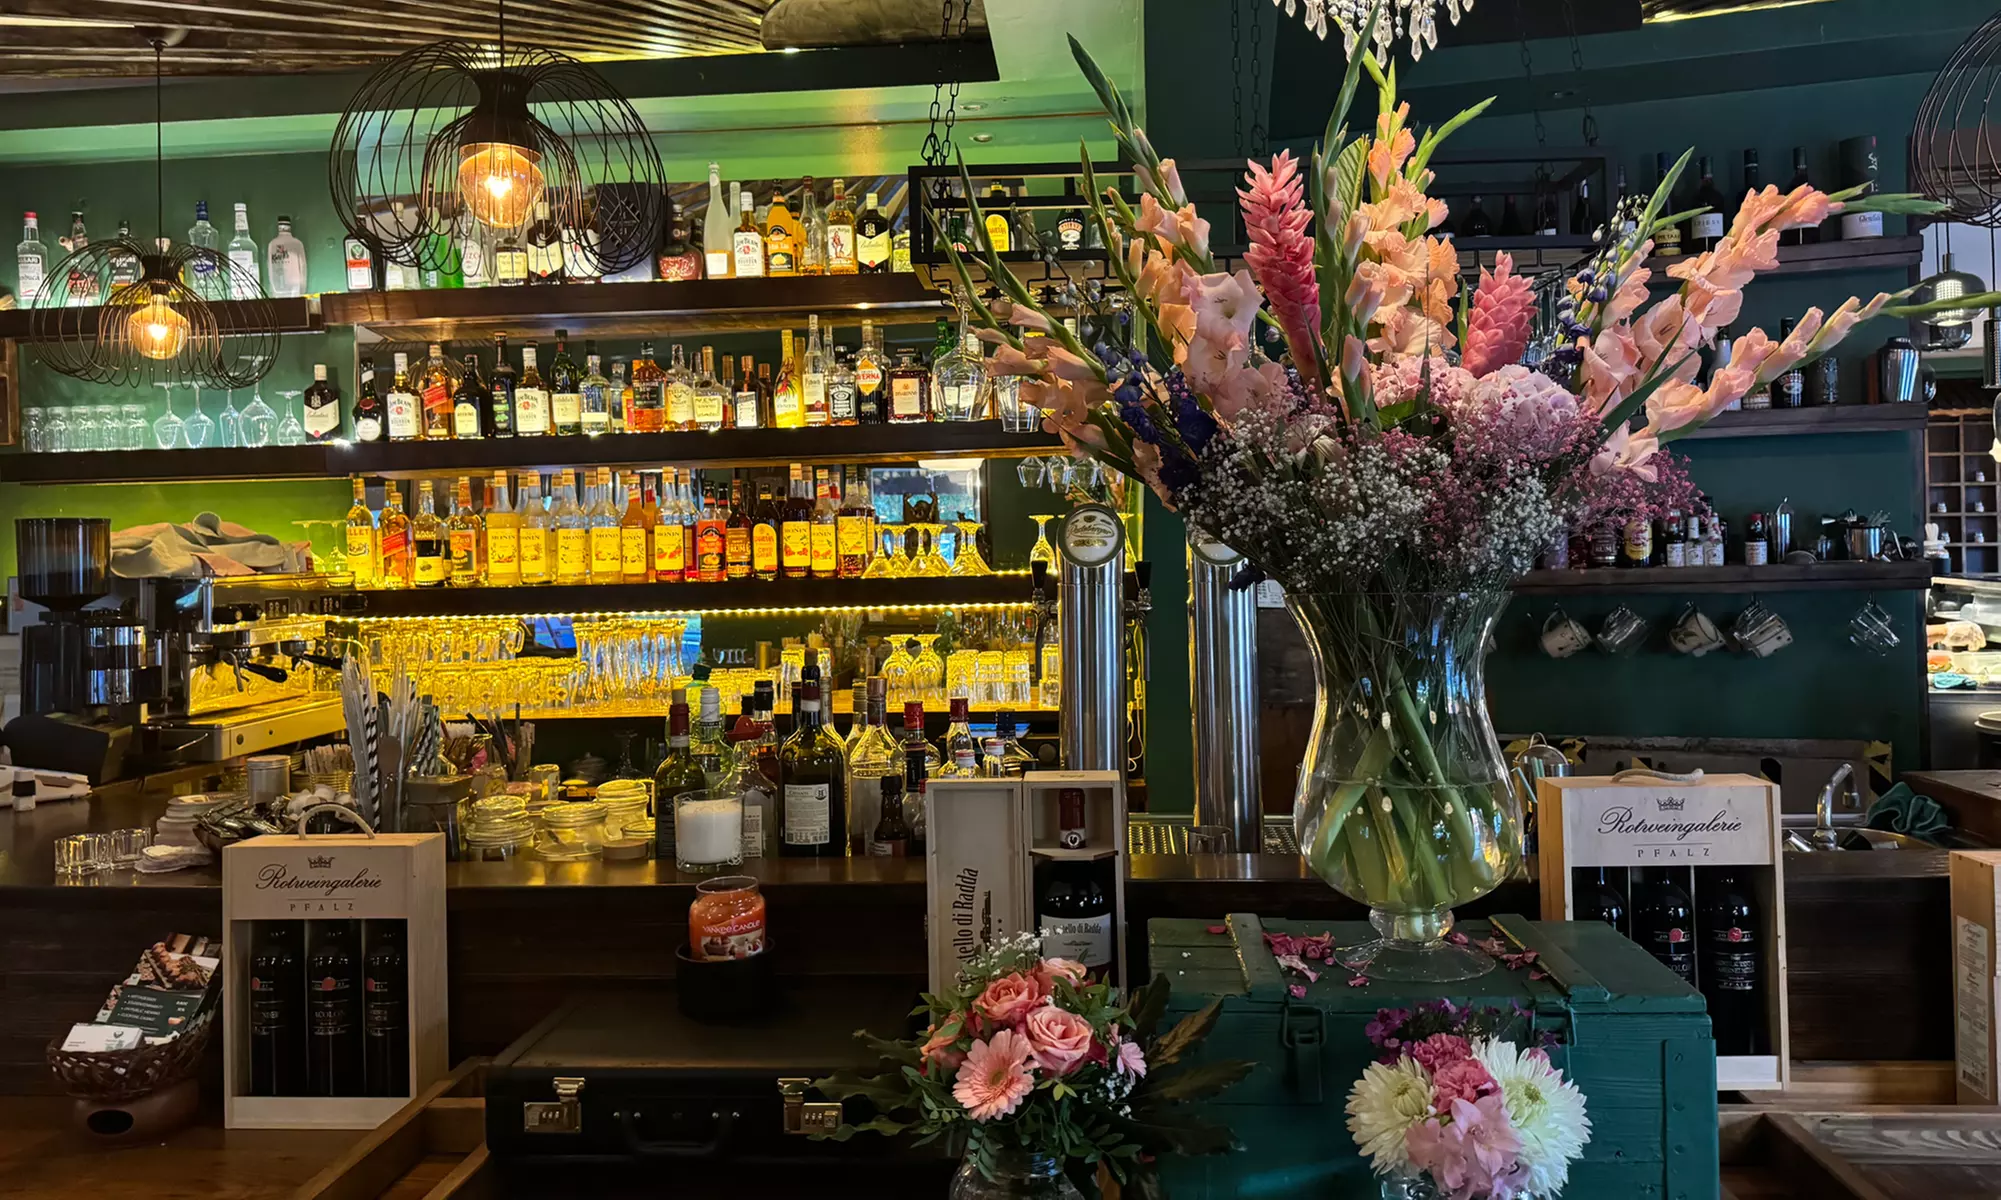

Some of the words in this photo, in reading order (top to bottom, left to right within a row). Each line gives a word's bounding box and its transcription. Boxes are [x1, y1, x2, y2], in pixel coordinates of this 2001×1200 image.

[1597, 806, 1742, 841] Rotweingalerie
[1637, 848, 1710, 858] PFALZ
[255, 863, 382, 896] Rotweingalerie
[952, 868, 979, 910] Radda
[290, 902, 353, 912] PFALZ
[732, 919, 761, 933] CANDLE
[1084, 921, 1102, 935] Radda
